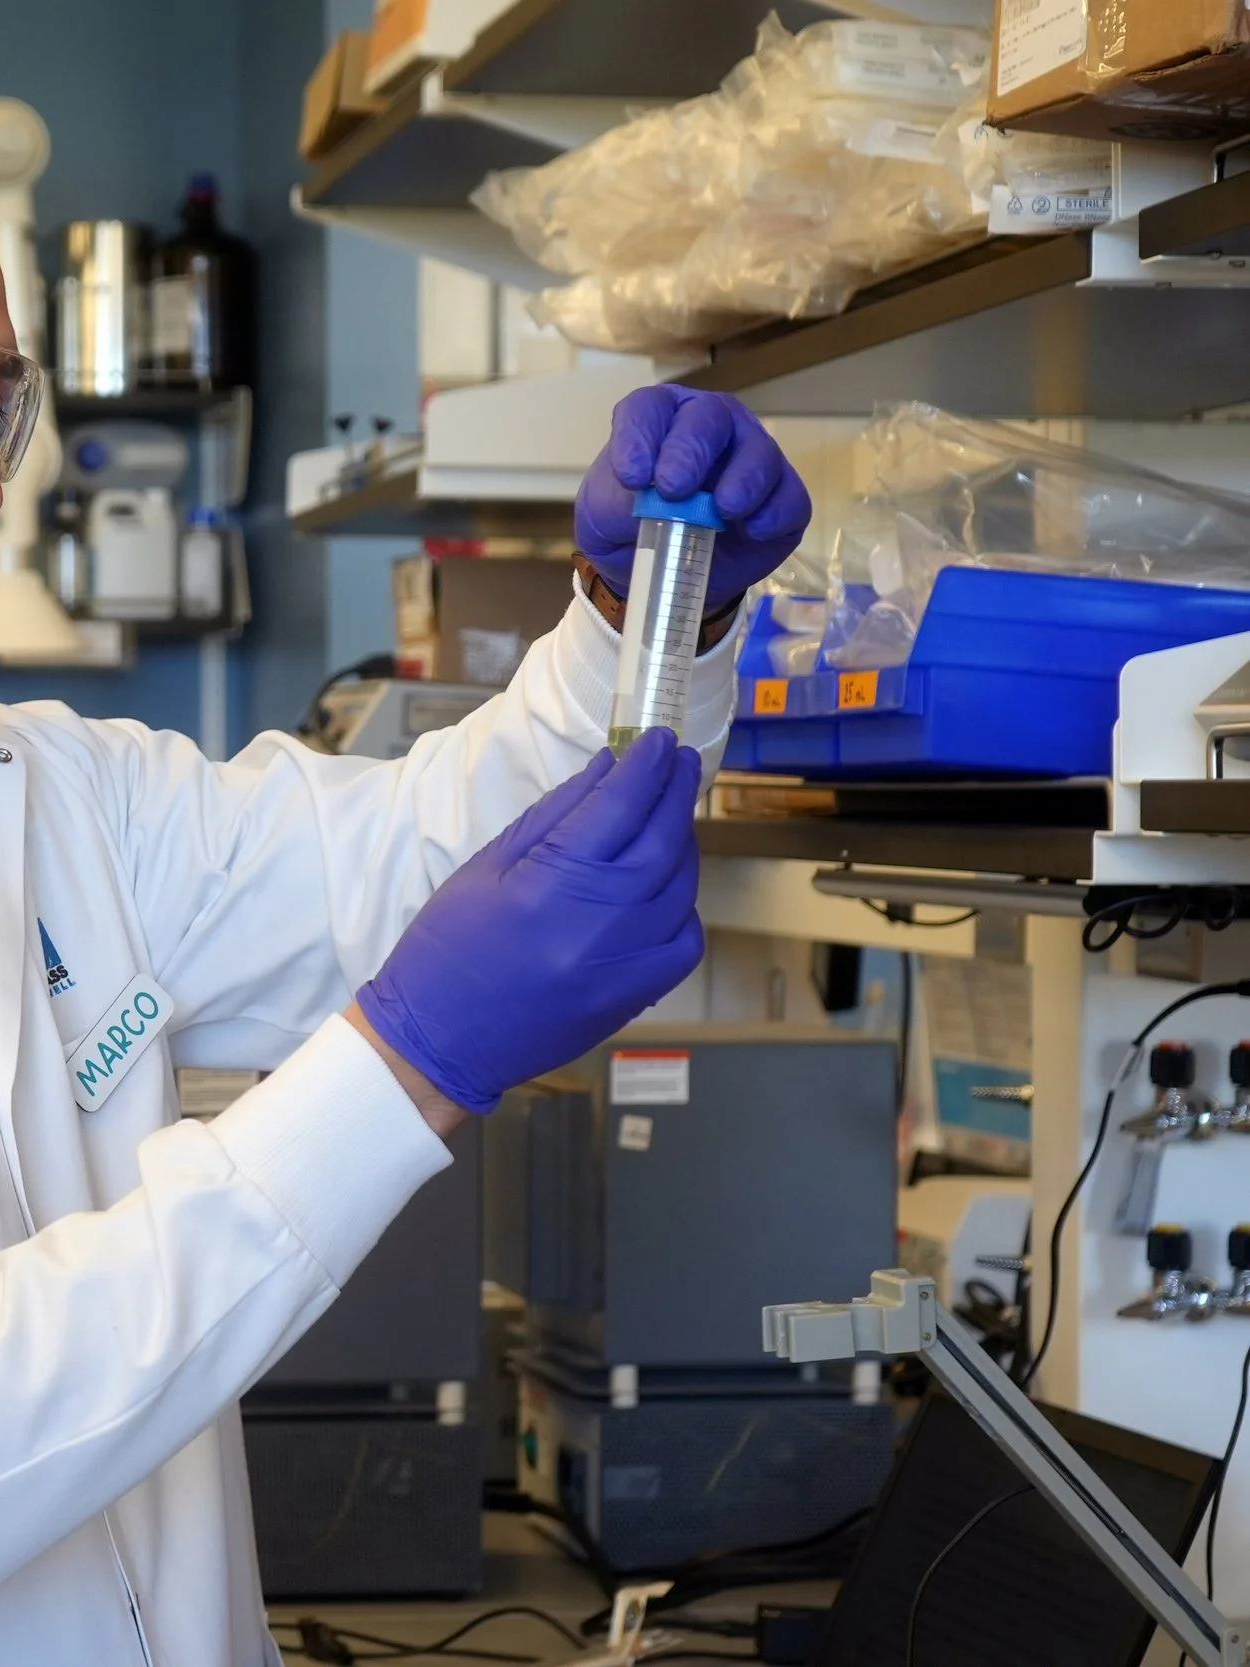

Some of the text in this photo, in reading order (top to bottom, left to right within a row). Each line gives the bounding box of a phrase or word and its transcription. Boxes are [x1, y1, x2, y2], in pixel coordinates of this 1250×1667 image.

[1065, 198, 1109, 208] STERILE
[669, 663, 679, 672] 20
[665, 687, 676, 696] 15
[661, 712, 671, 721] 10
[49, 978, 77, 998] ELL
[76, 991, 159, 1097] MARCO
